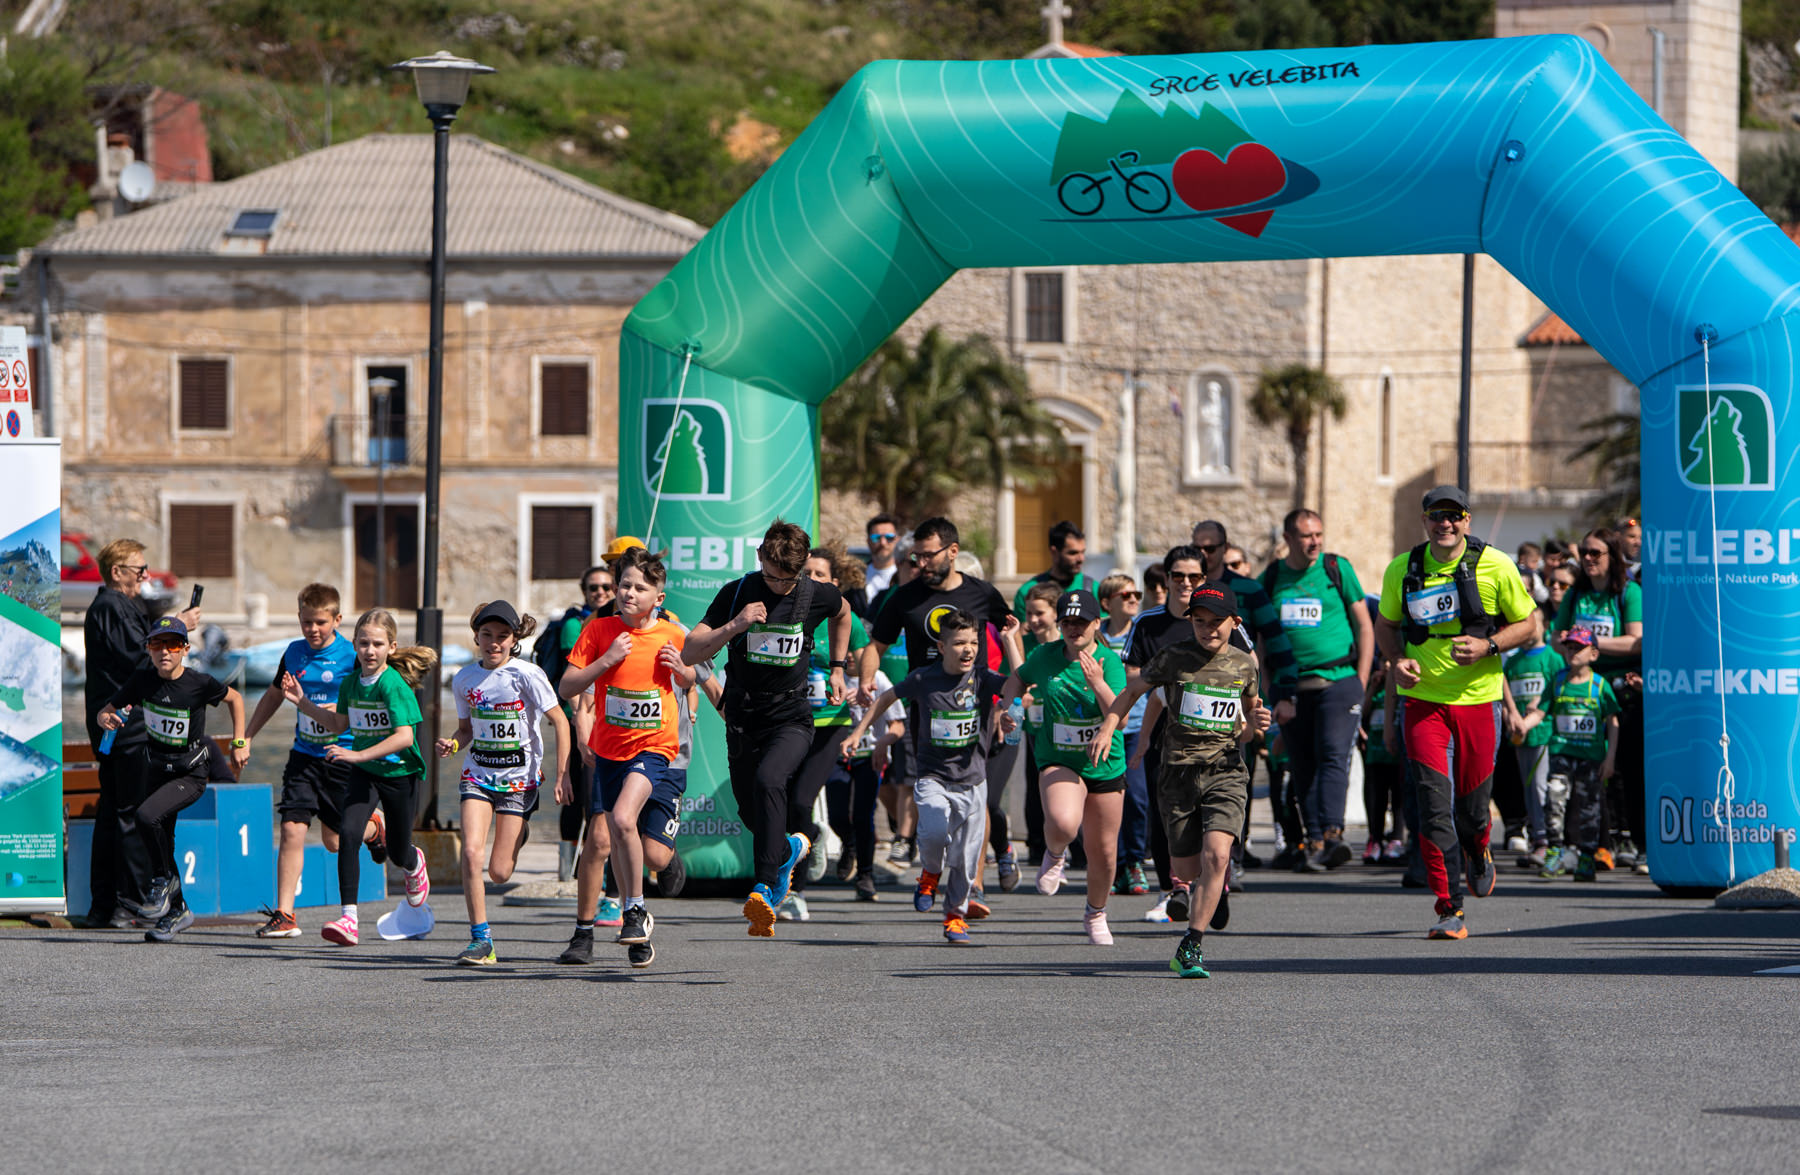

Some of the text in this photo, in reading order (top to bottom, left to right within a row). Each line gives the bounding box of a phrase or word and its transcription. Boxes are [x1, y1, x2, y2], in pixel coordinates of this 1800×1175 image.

[1150, 61, 1360, 97] SRCE VELEBITA
[1726, 573, 1769, 585] Nature
[1771, 571, 1799, 585] Park
[1437, 595, 1453, 611] 69
[1300, 606, 1318, 618] 110
[777, 637, 800, 655] 171
[1525, 681, 1541, 692] 177
[1648, 668, 1800, 695] GRAFIKNE
[630, 702, 660, 718] 202
[1211, 701, 1236, 718] 170
[161, 719, 185, 735] 179
[310, 720, 331, 734] 16
[364, 712, 390, 728] 198
[1573, 718, 1595, 732] 169
[489, 723, 517, 739] 184
[956, 720, 978, 737] 155
[238, 823, 249, 856] 1
[184, 851, 196, 884] 2
